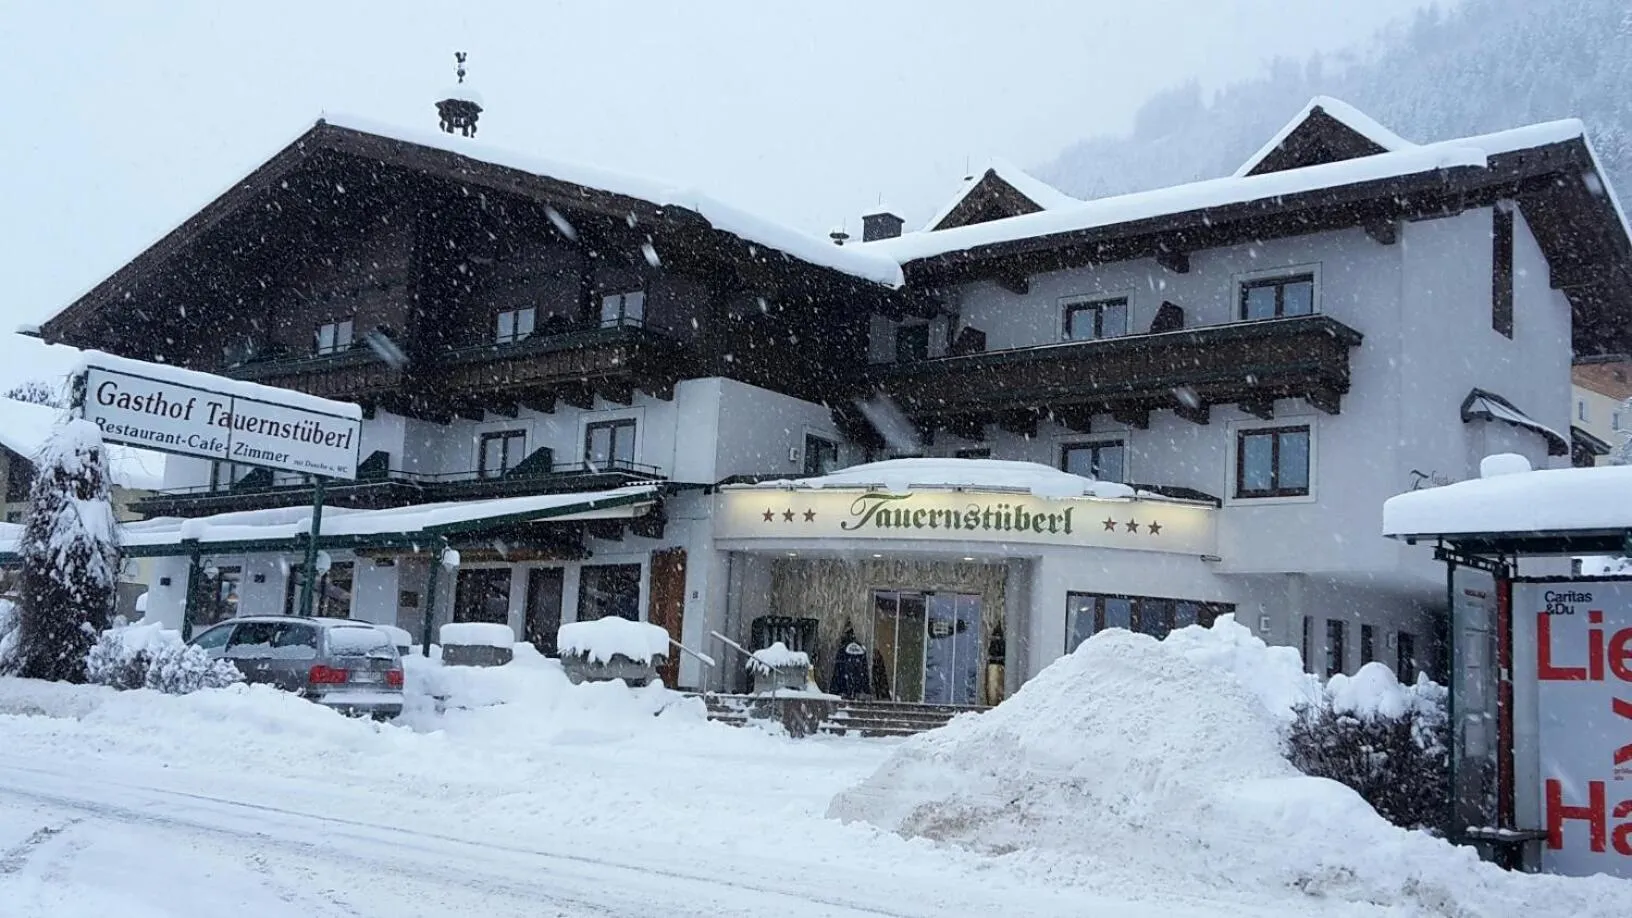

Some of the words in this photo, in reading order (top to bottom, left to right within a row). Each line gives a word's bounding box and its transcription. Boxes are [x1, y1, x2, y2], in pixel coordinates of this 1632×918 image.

[97, 380, 196, 421] Gasthof
[206, 401, 353, 449] Tauernstüberl
[840, 493, 1074, 535] Tauernstüberl
[1544, 590, 1593, 603] Caritas
[1546, 602, 1575, 615] &Du
